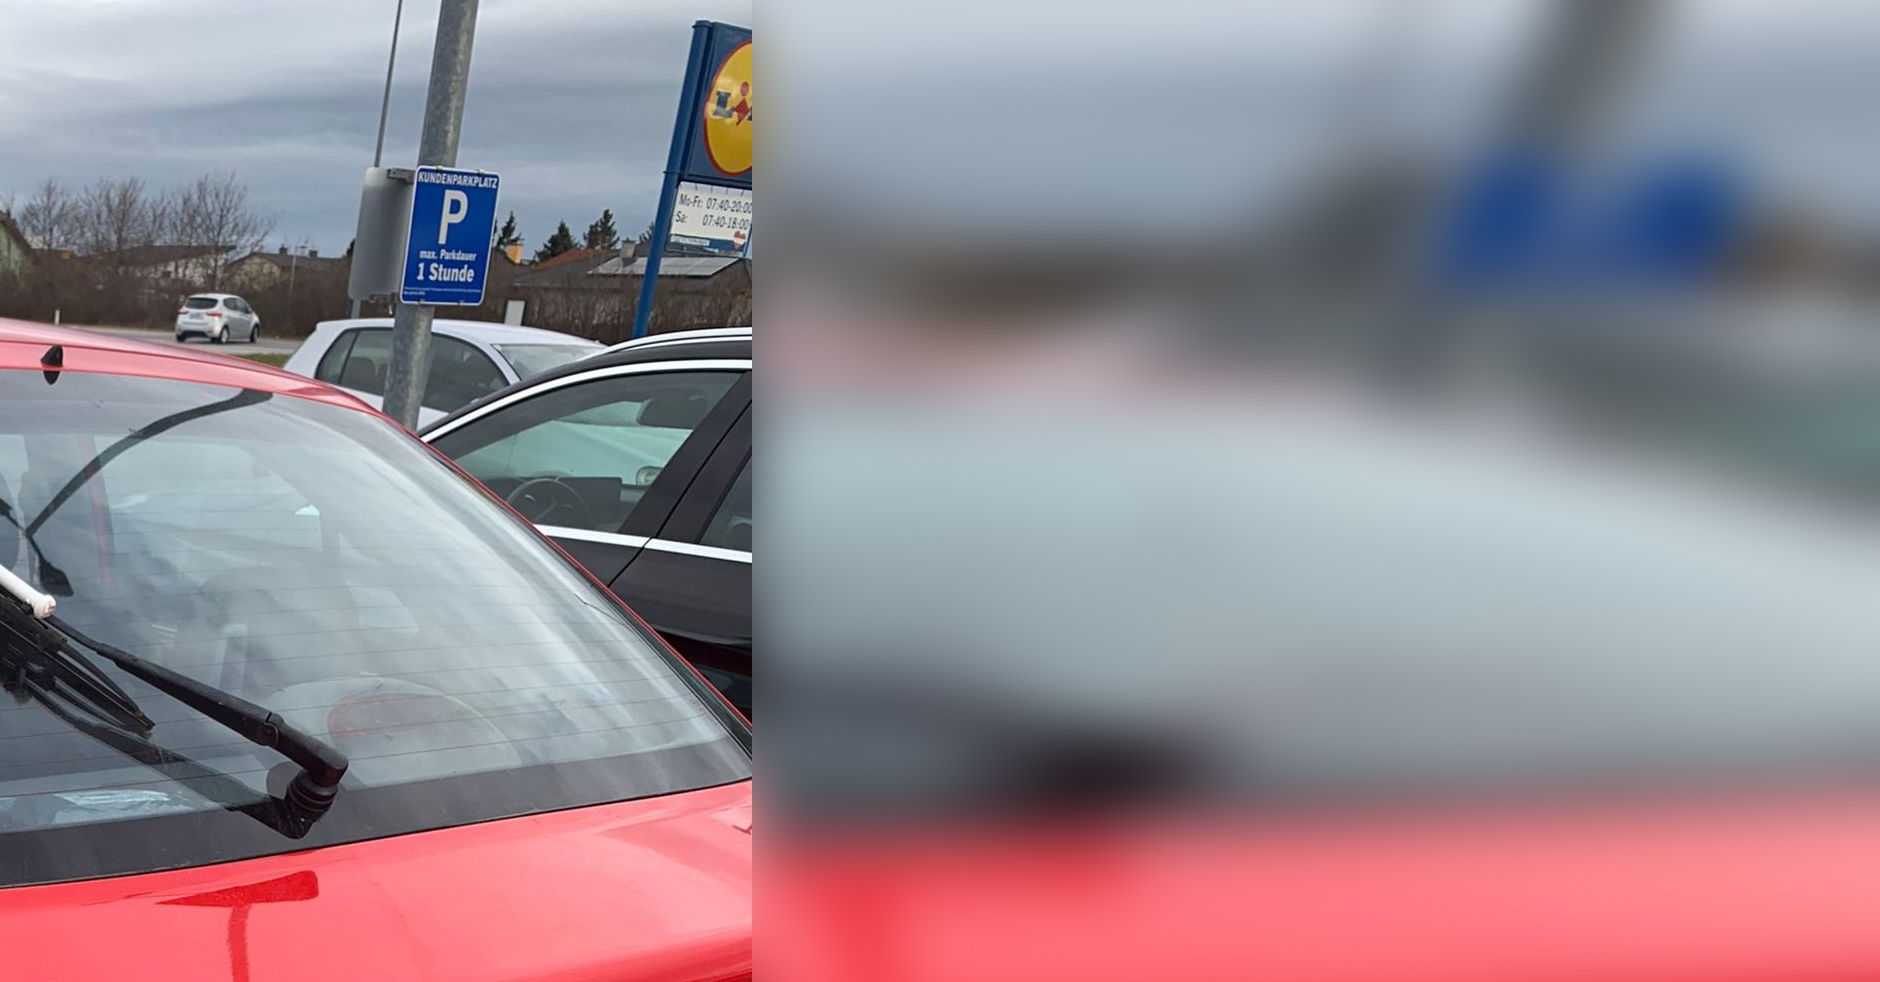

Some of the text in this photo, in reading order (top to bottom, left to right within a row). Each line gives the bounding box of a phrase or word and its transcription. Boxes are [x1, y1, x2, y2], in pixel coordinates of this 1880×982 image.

[418, 171, 498, 188] KUNDENPARKPLATZ
[438, 189, 469, 245] P
[419, 249, 477, 261] max. Parkdauer
[416, 262, 475, 282] 1 Stunde
